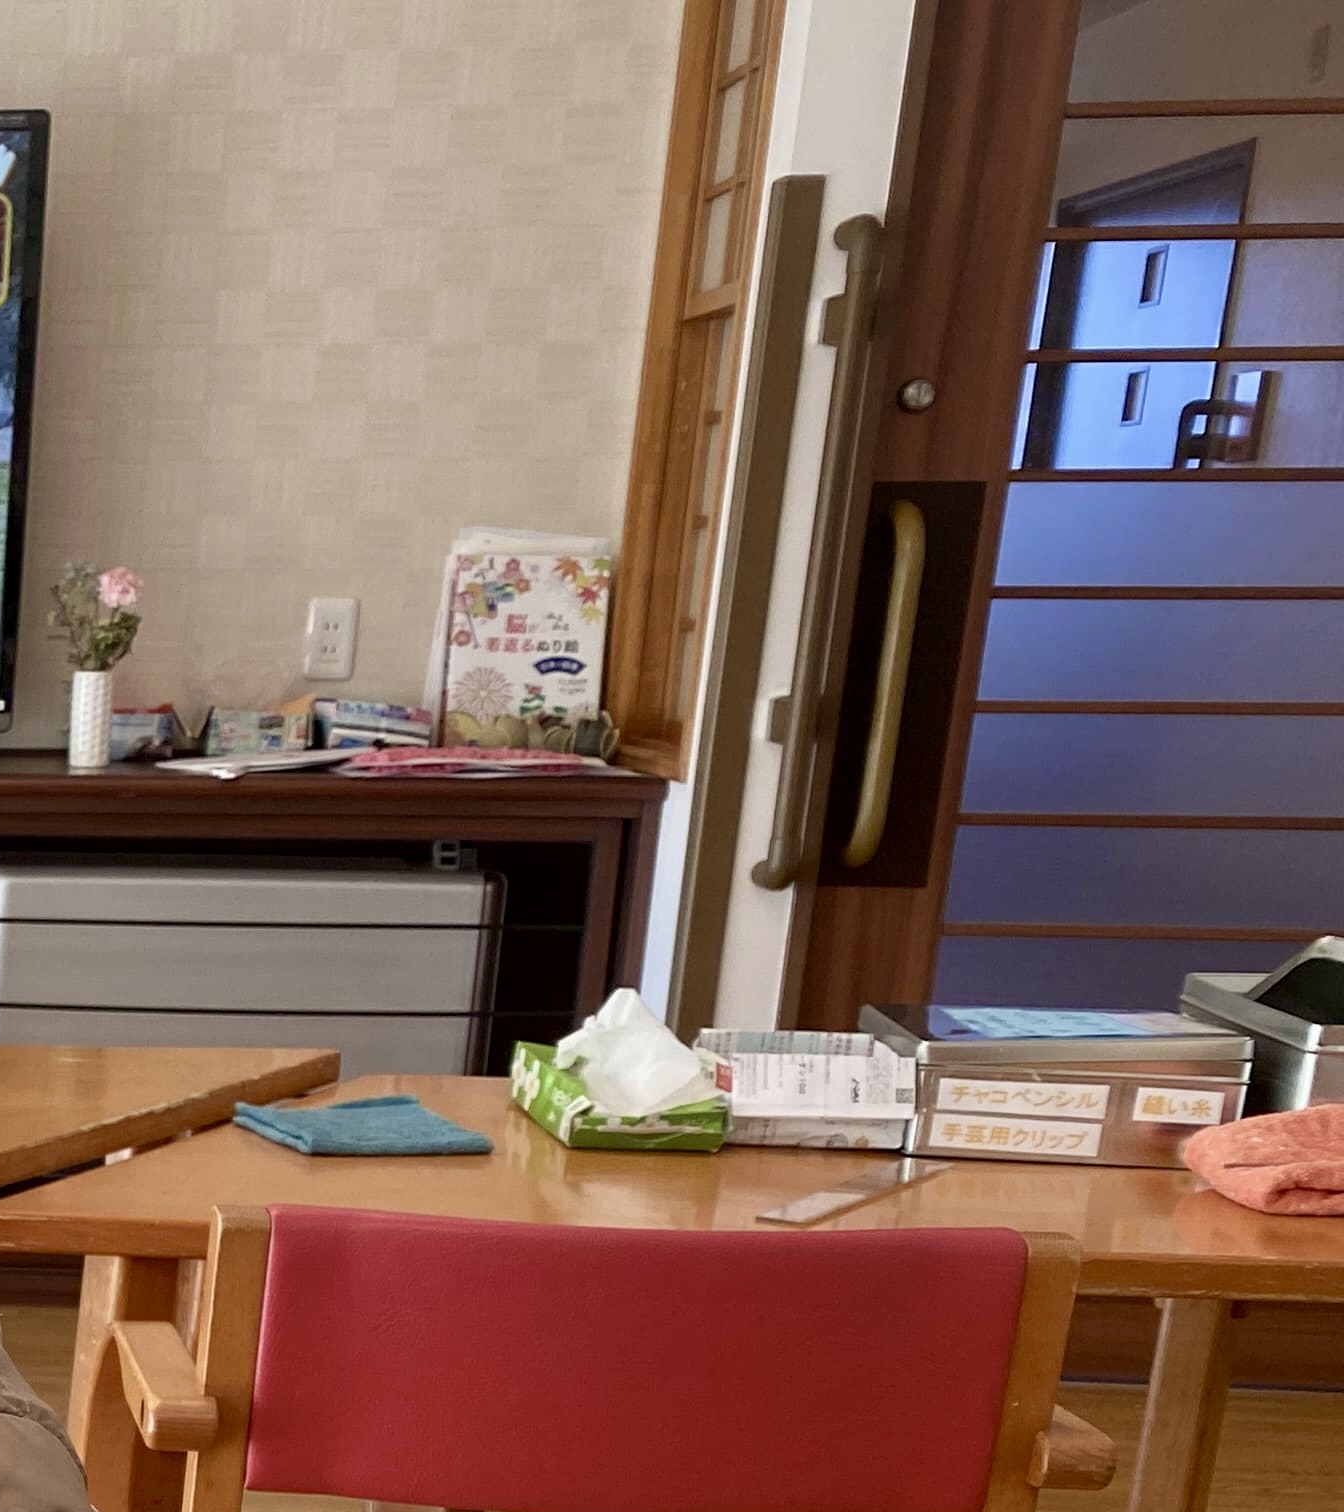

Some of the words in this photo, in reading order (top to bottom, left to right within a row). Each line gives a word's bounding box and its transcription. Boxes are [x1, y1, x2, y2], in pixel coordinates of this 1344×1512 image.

[952, 1085, 1099, 1110] チャコペンシル
[942, 1122, 1090, 1150] 手芸用クリップ
